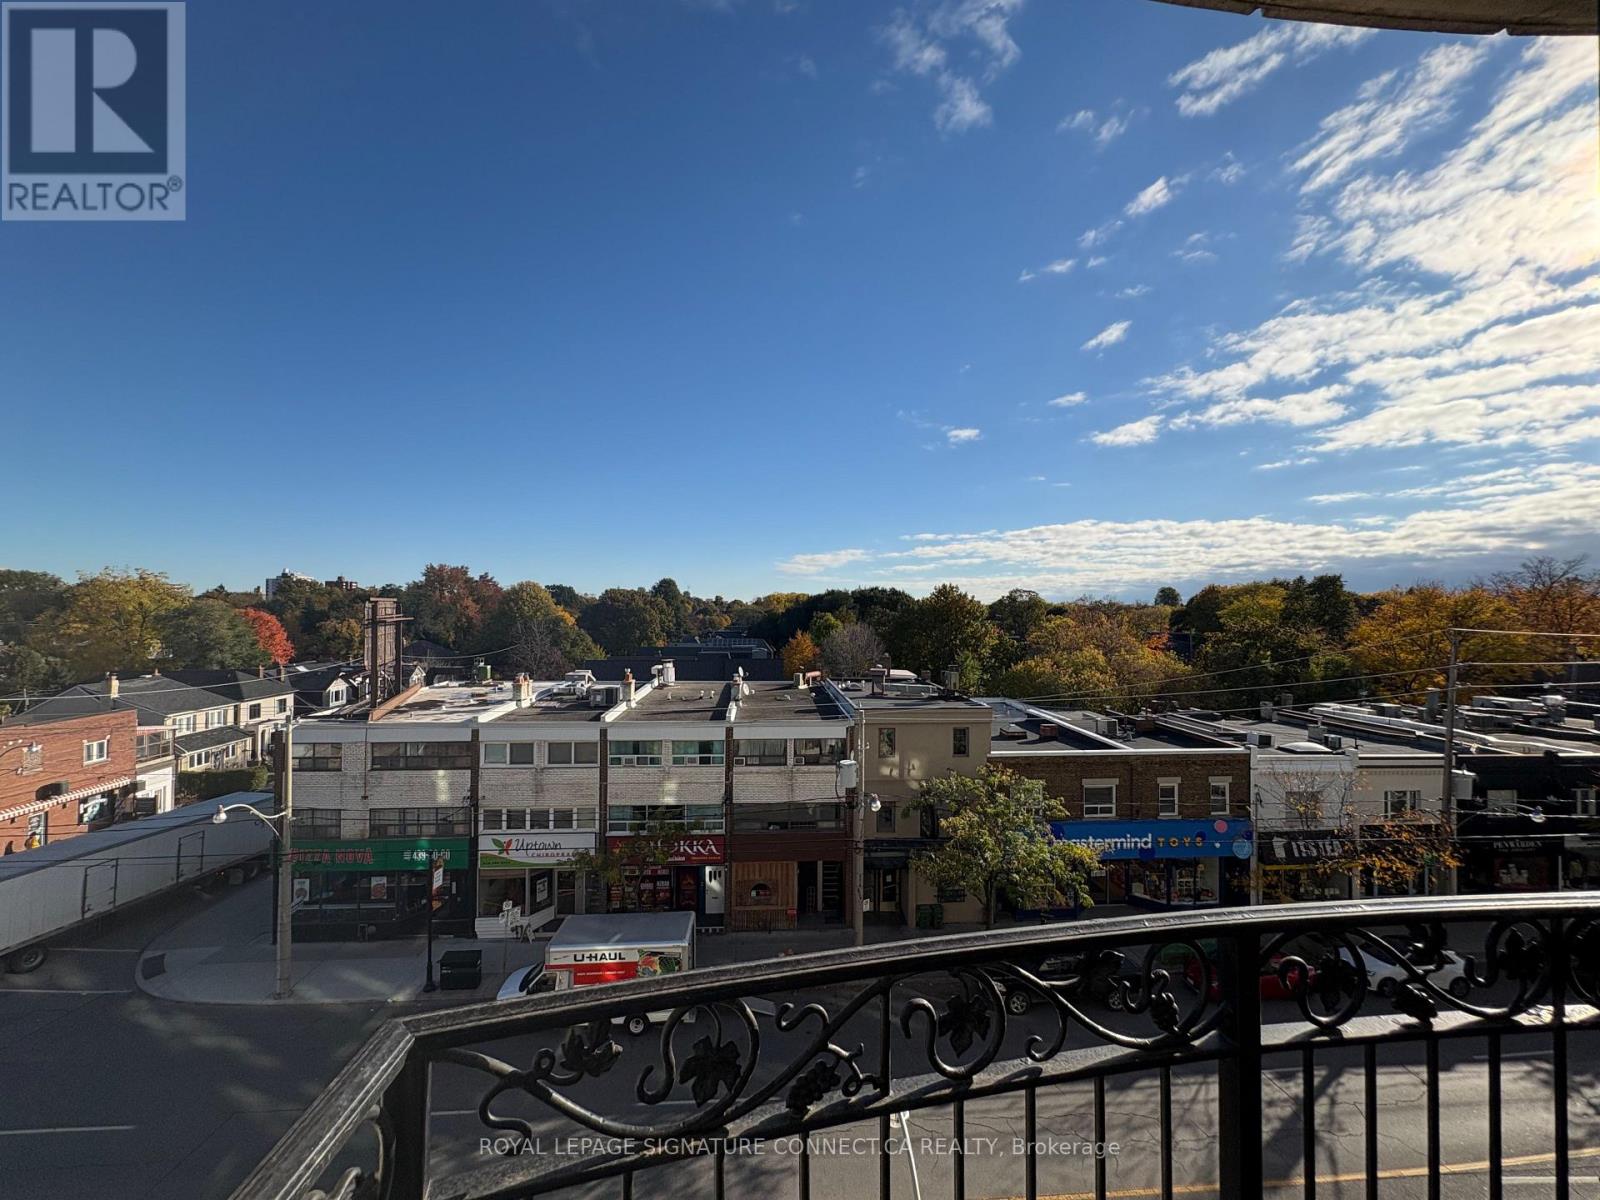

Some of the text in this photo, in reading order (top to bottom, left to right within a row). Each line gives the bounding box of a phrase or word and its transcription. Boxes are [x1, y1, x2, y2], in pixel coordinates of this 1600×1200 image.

[514, 838, 562, 856] Uptown
[1157, 836, 1203, 847] TOYS
[336, 848, 373, 864] NOVA
[573, 952, 626, 962] U-HAUL
